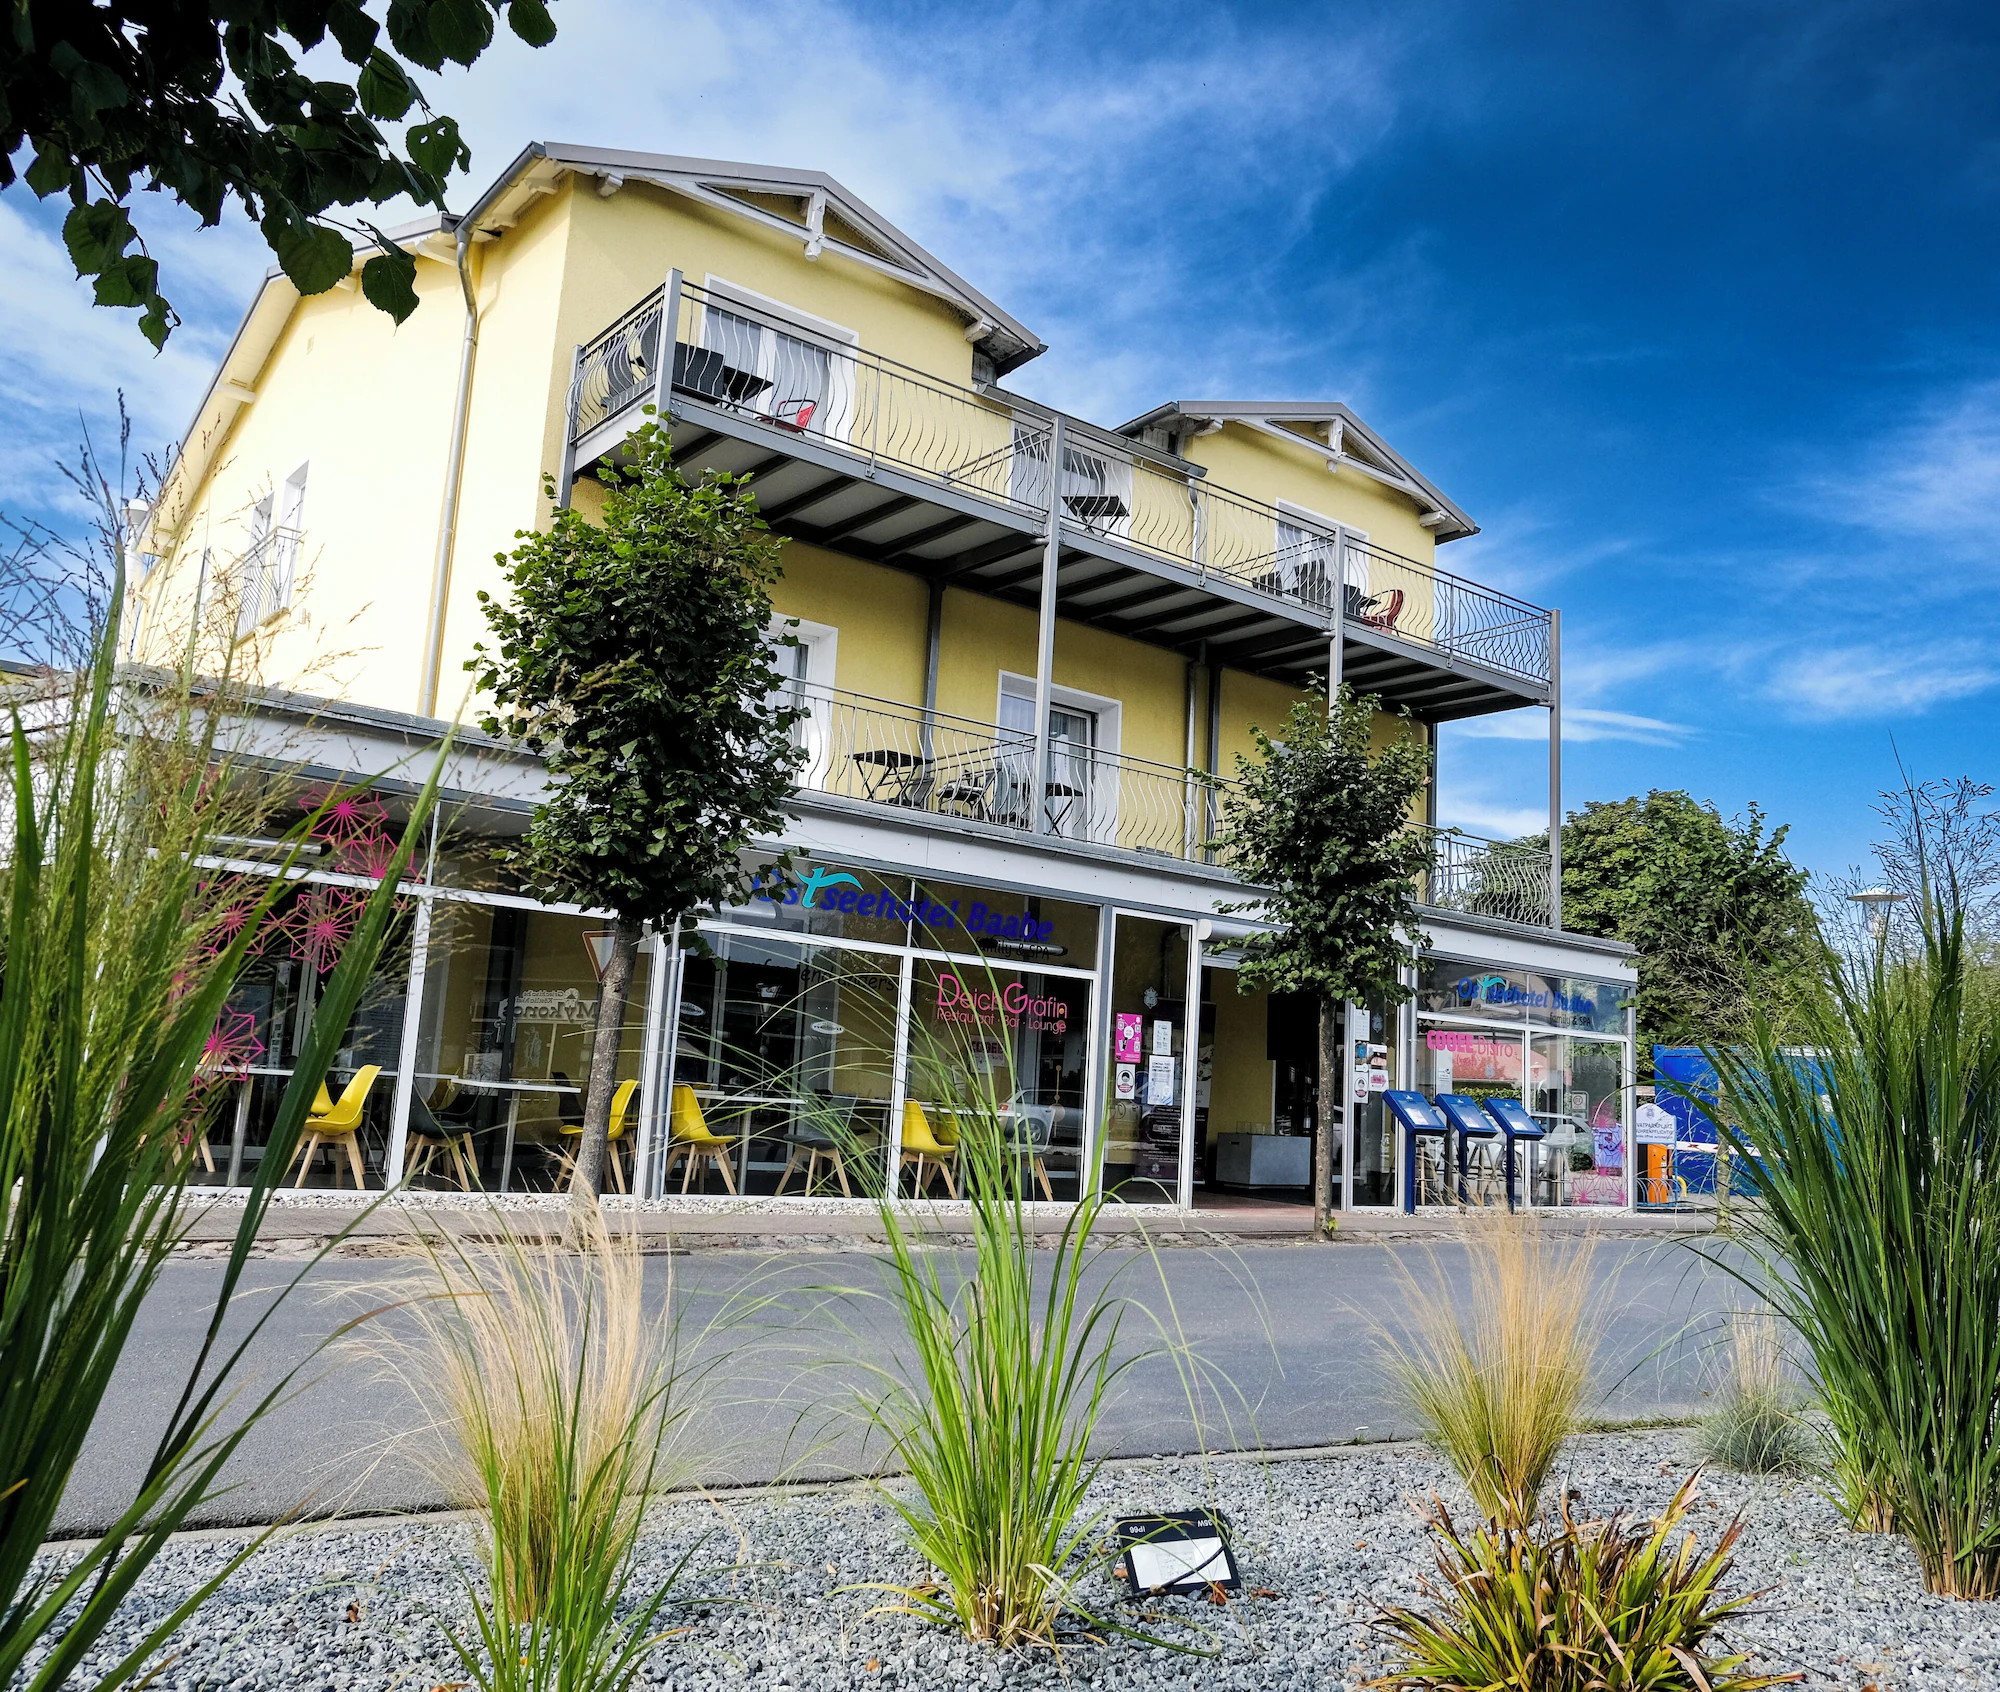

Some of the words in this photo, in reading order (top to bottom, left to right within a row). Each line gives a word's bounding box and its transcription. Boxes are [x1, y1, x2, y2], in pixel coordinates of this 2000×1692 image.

[966, 901, 1054, 942] Baabe
[1016, 943, 1024, 956] &
[1029, 944, 1050, 960] SPA
[1458, 974, 1549, 1009] Ostseehotel
[1552, 991, 1594, 1014] Baabe
[1028, 1017, 1067, 1035] Lounge
[1427, 1029, 1474, 1054] COOEE
[1129, 1525, 1146, 1534] IP66
